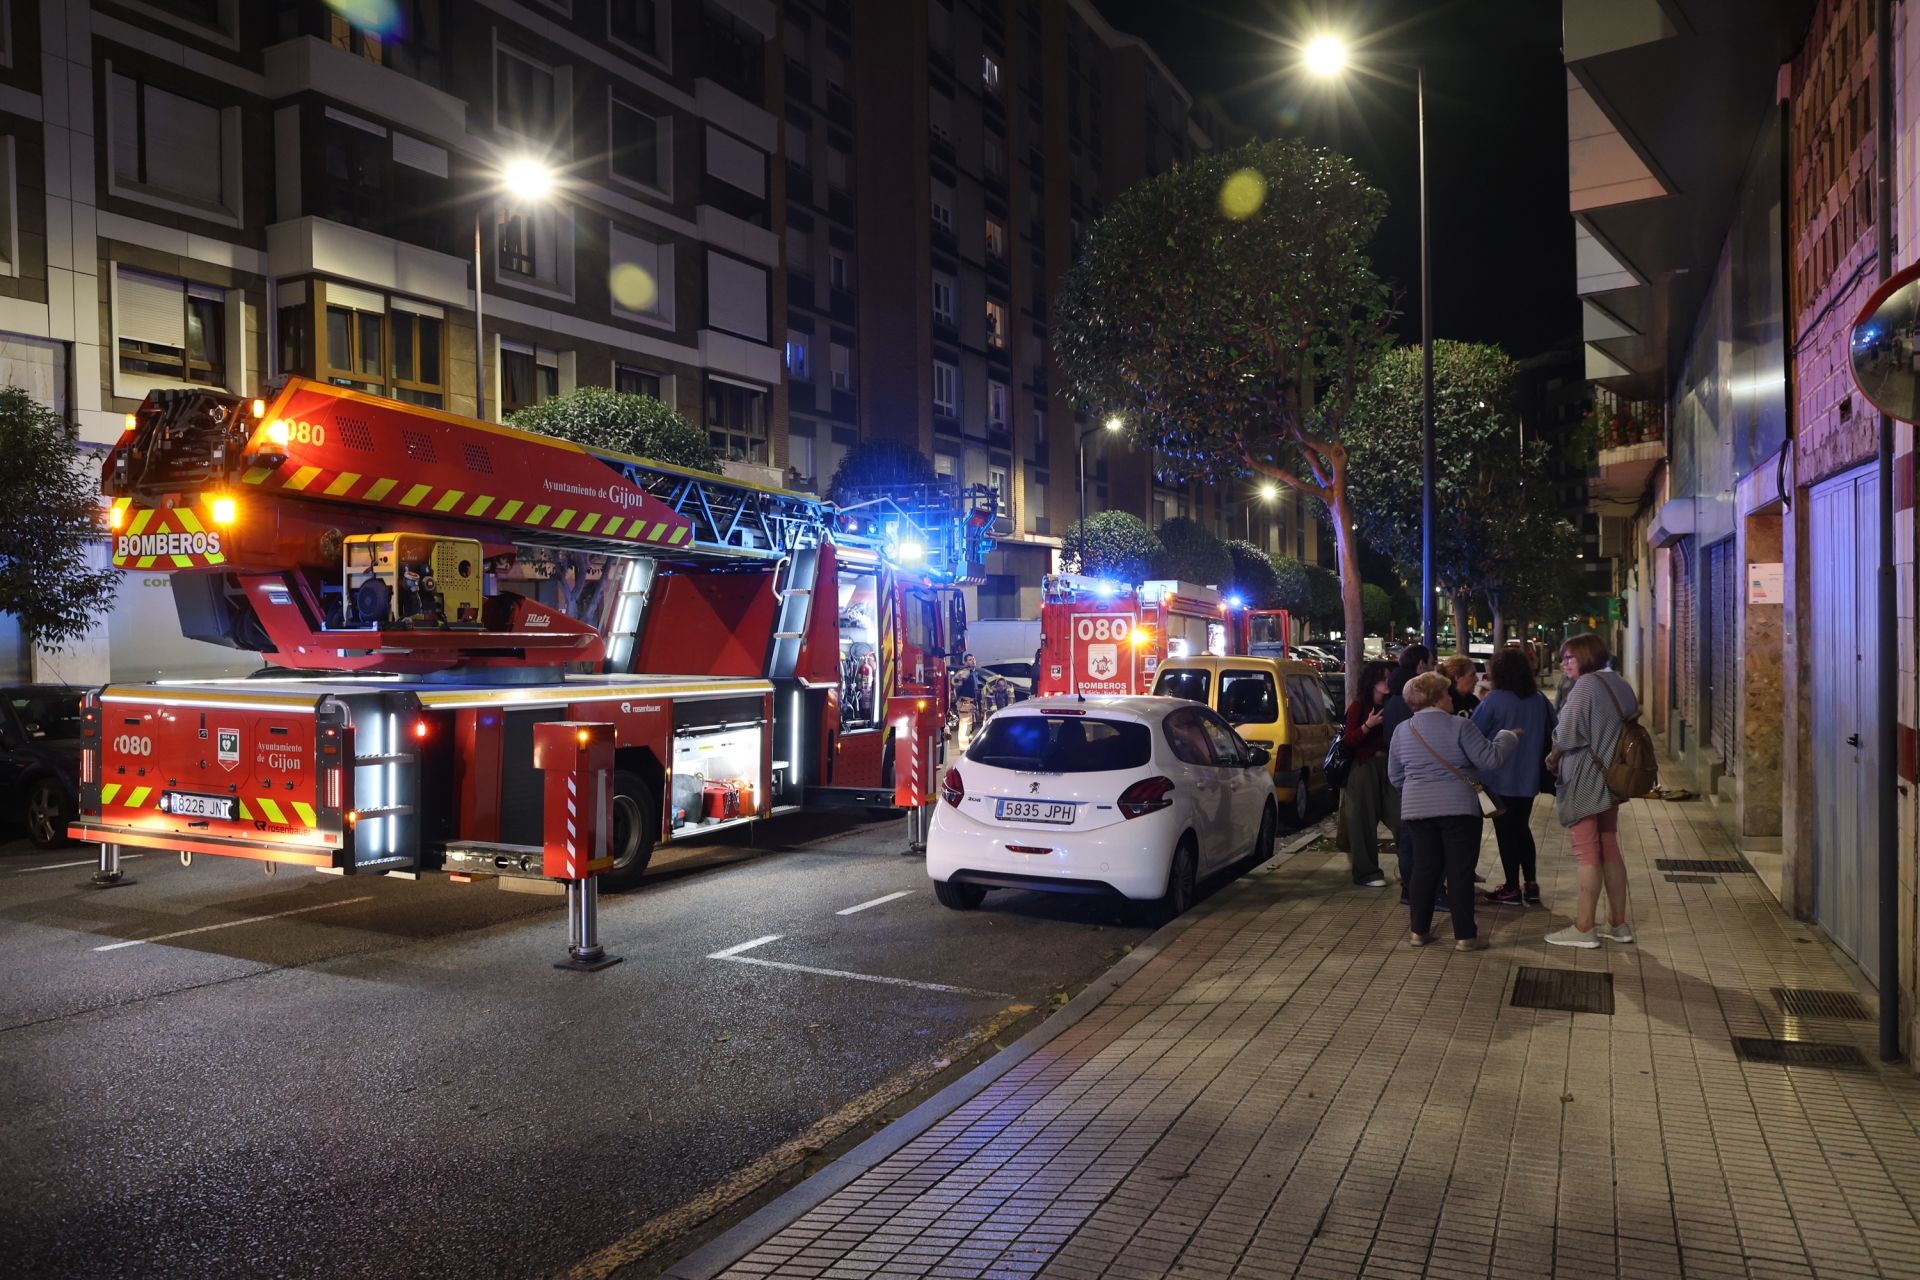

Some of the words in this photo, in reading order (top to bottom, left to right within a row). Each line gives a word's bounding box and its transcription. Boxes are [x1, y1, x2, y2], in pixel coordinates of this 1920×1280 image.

[283, 418, 325, 447] 080
[543, 479, 596, 497] Ayuntamiento
[598, 488, 607, 499] de
[118, 531, 220, 557] BOMBEROS
[526, 613, 551, 624] Metz
[1078, 618, 1128, 641] 080
[1078, 682, 1127, 690] BOMBEROS
[119, 734, 152, 756] 080
[257, 741, 302, 753] Ayuntamiento
[256, 753, 265, 763] de
[178, 798, 205, 814] 8226
[209, 801, 229, 817] JNT
[1006, 802, 1040, 818] 5835
[1044, 805, 1072, 821] JPH
